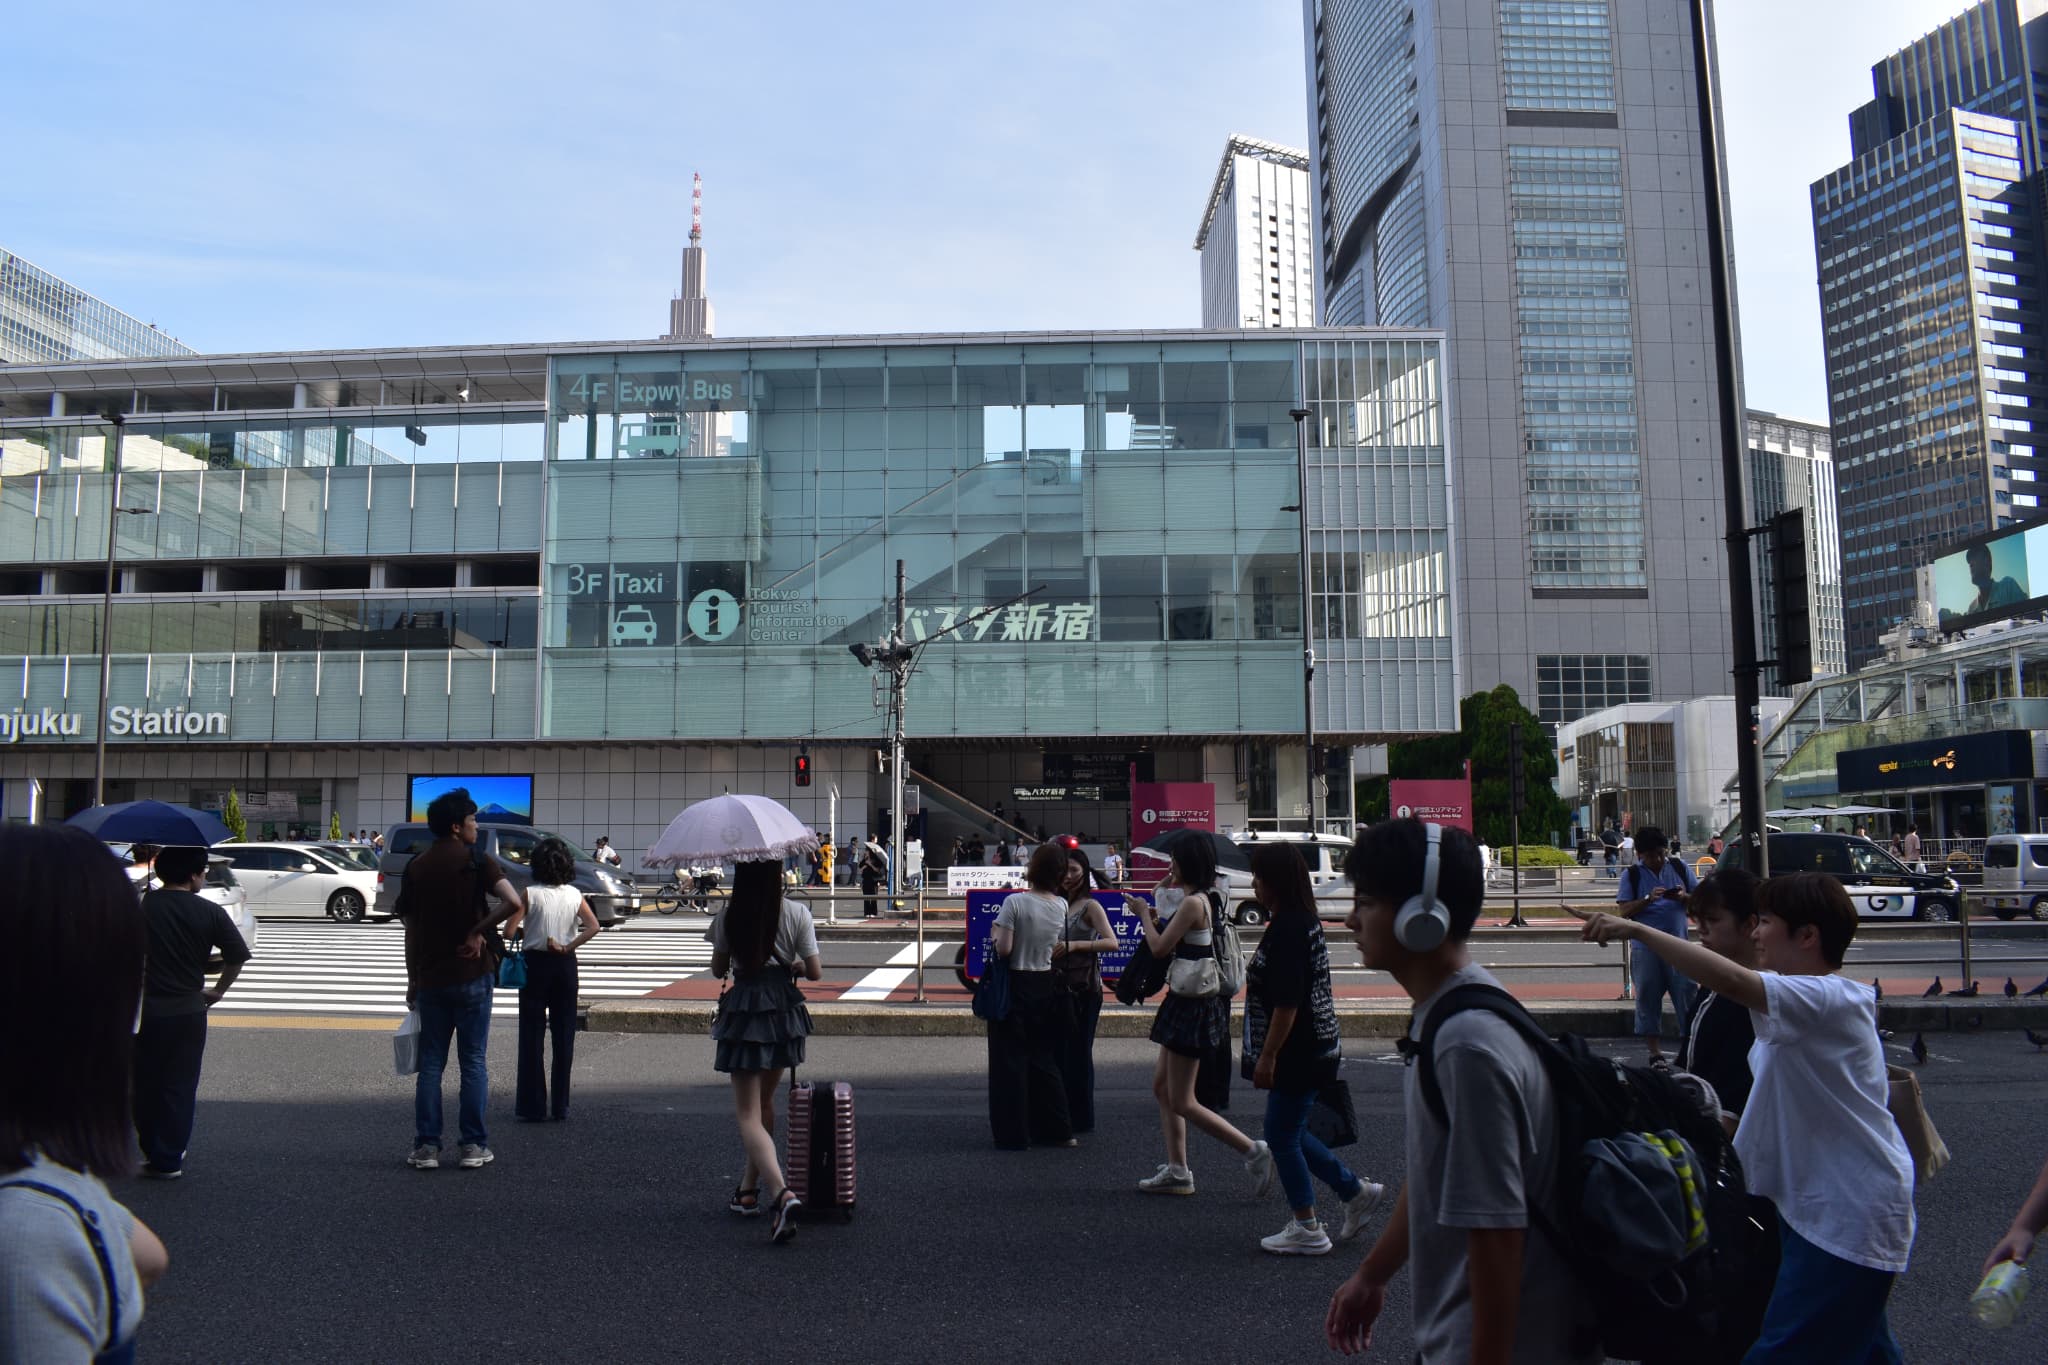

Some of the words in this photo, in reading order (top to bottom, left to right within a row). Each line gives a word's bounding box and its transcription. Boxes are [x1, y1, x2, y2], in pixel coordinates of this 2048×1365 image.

[569, 374, 608, 402] 4F
[619, 381, 689, 406] Expwy.
[694, 379, 732, 400] Bus
[568, 563, 602, 595] 3F
[615, 572, 663, 594] Taxi
[750, 587, 799, 601] Tokyo
[750, 601, 809, 614] Tourist
[750, 614, 847, 628] Information
[886, 601, 1095, 641] バスタ新宿
[750, 629, 805, 642] Center
[109, 705, 227, 735] Station
